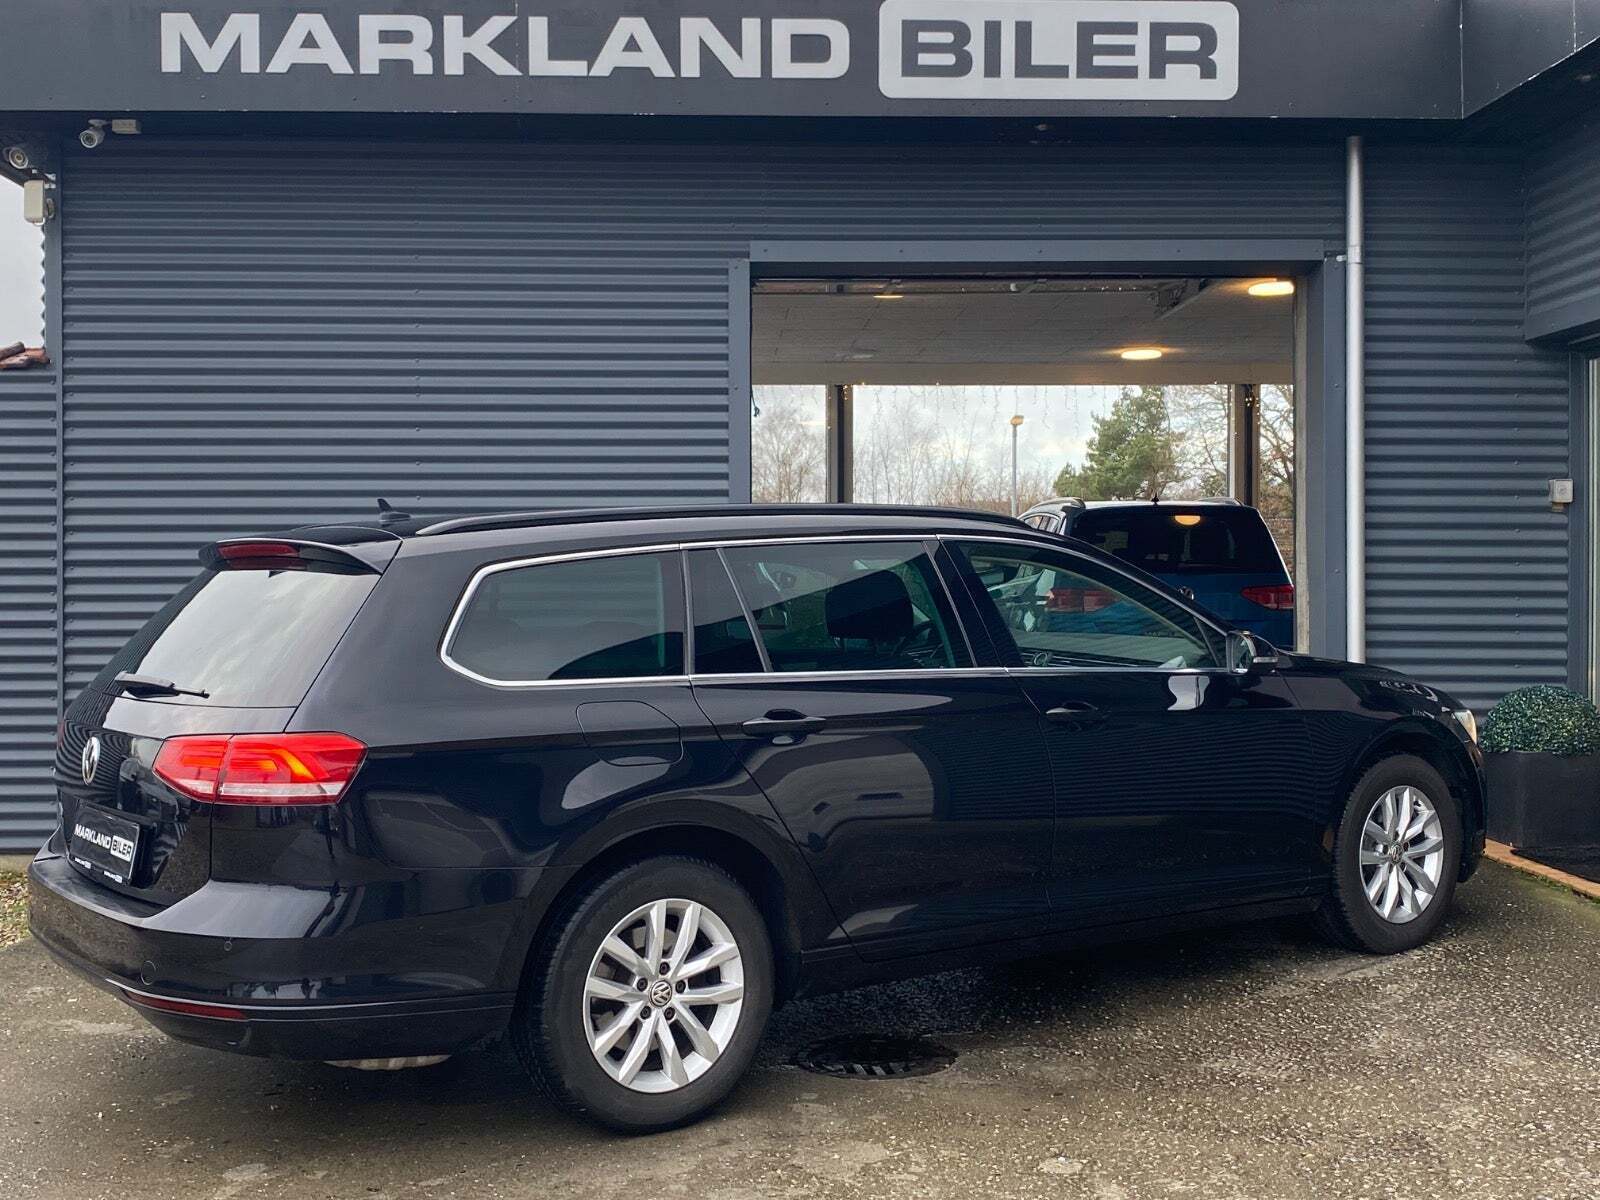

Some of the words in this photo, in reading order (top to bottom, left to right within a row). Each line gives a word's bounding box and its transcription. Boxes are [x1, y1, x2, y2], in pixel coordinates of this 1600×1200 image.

[160, 13, 850, 79] MARKLAND
[900, 20, 1218, 80] BILER
[74, 824, 111, 850] MARKLAND
[112, 838, 133, 857] BILER
